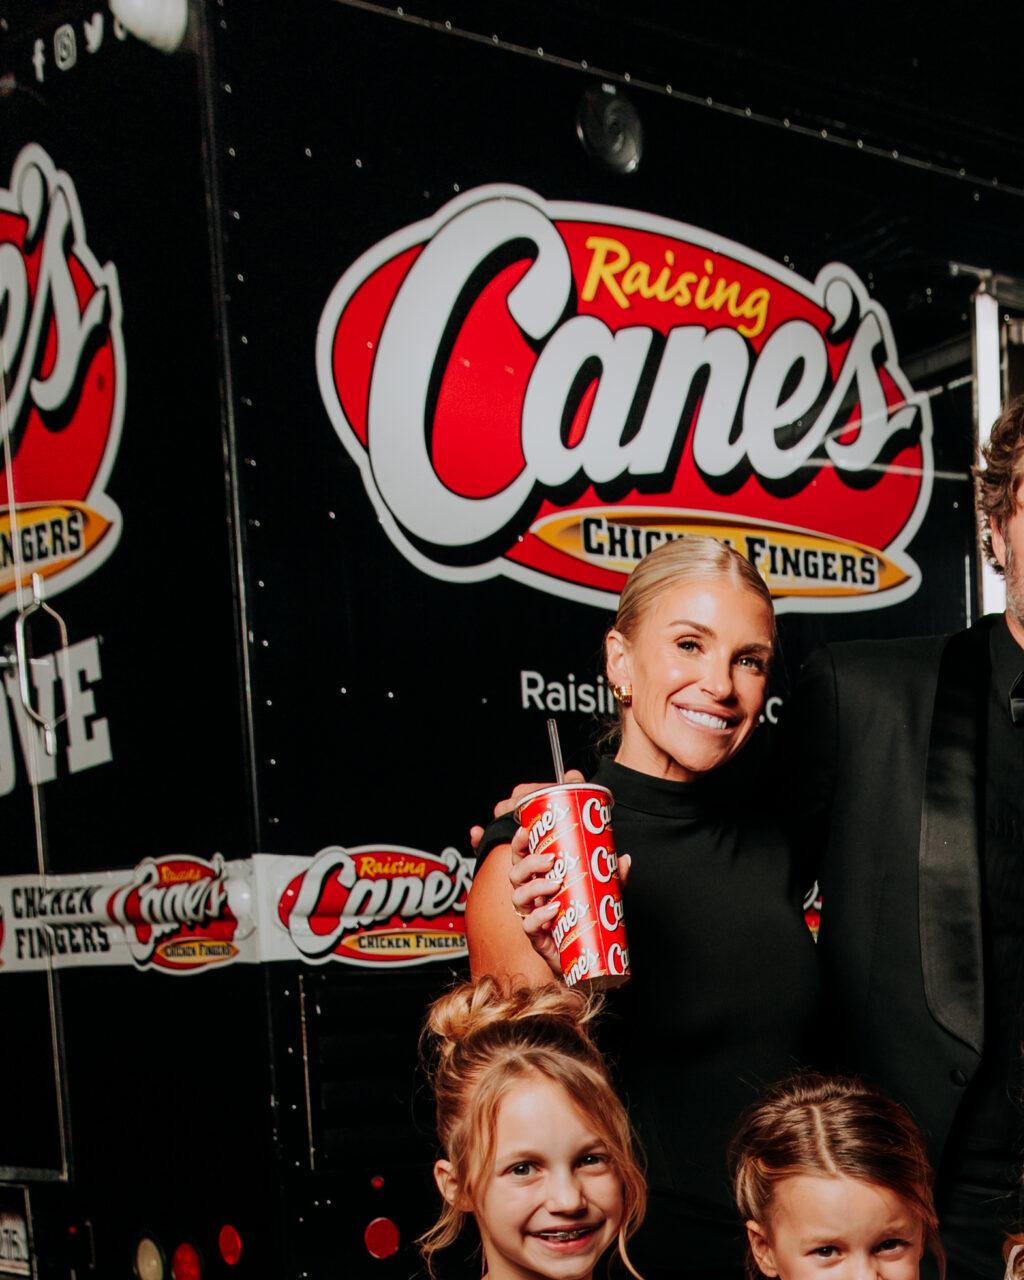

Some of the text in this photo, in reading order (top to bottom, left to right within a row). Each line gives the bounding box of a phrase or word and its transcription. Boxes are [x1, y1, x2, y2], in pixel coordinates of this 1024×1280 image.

[581, 236, 771, 338] Raising
[366, 196, 920, 547] Cane's
[745, 536, 877, 586] FINGERS
[357, 934, 466, 949] CHICKEN FINGERS
